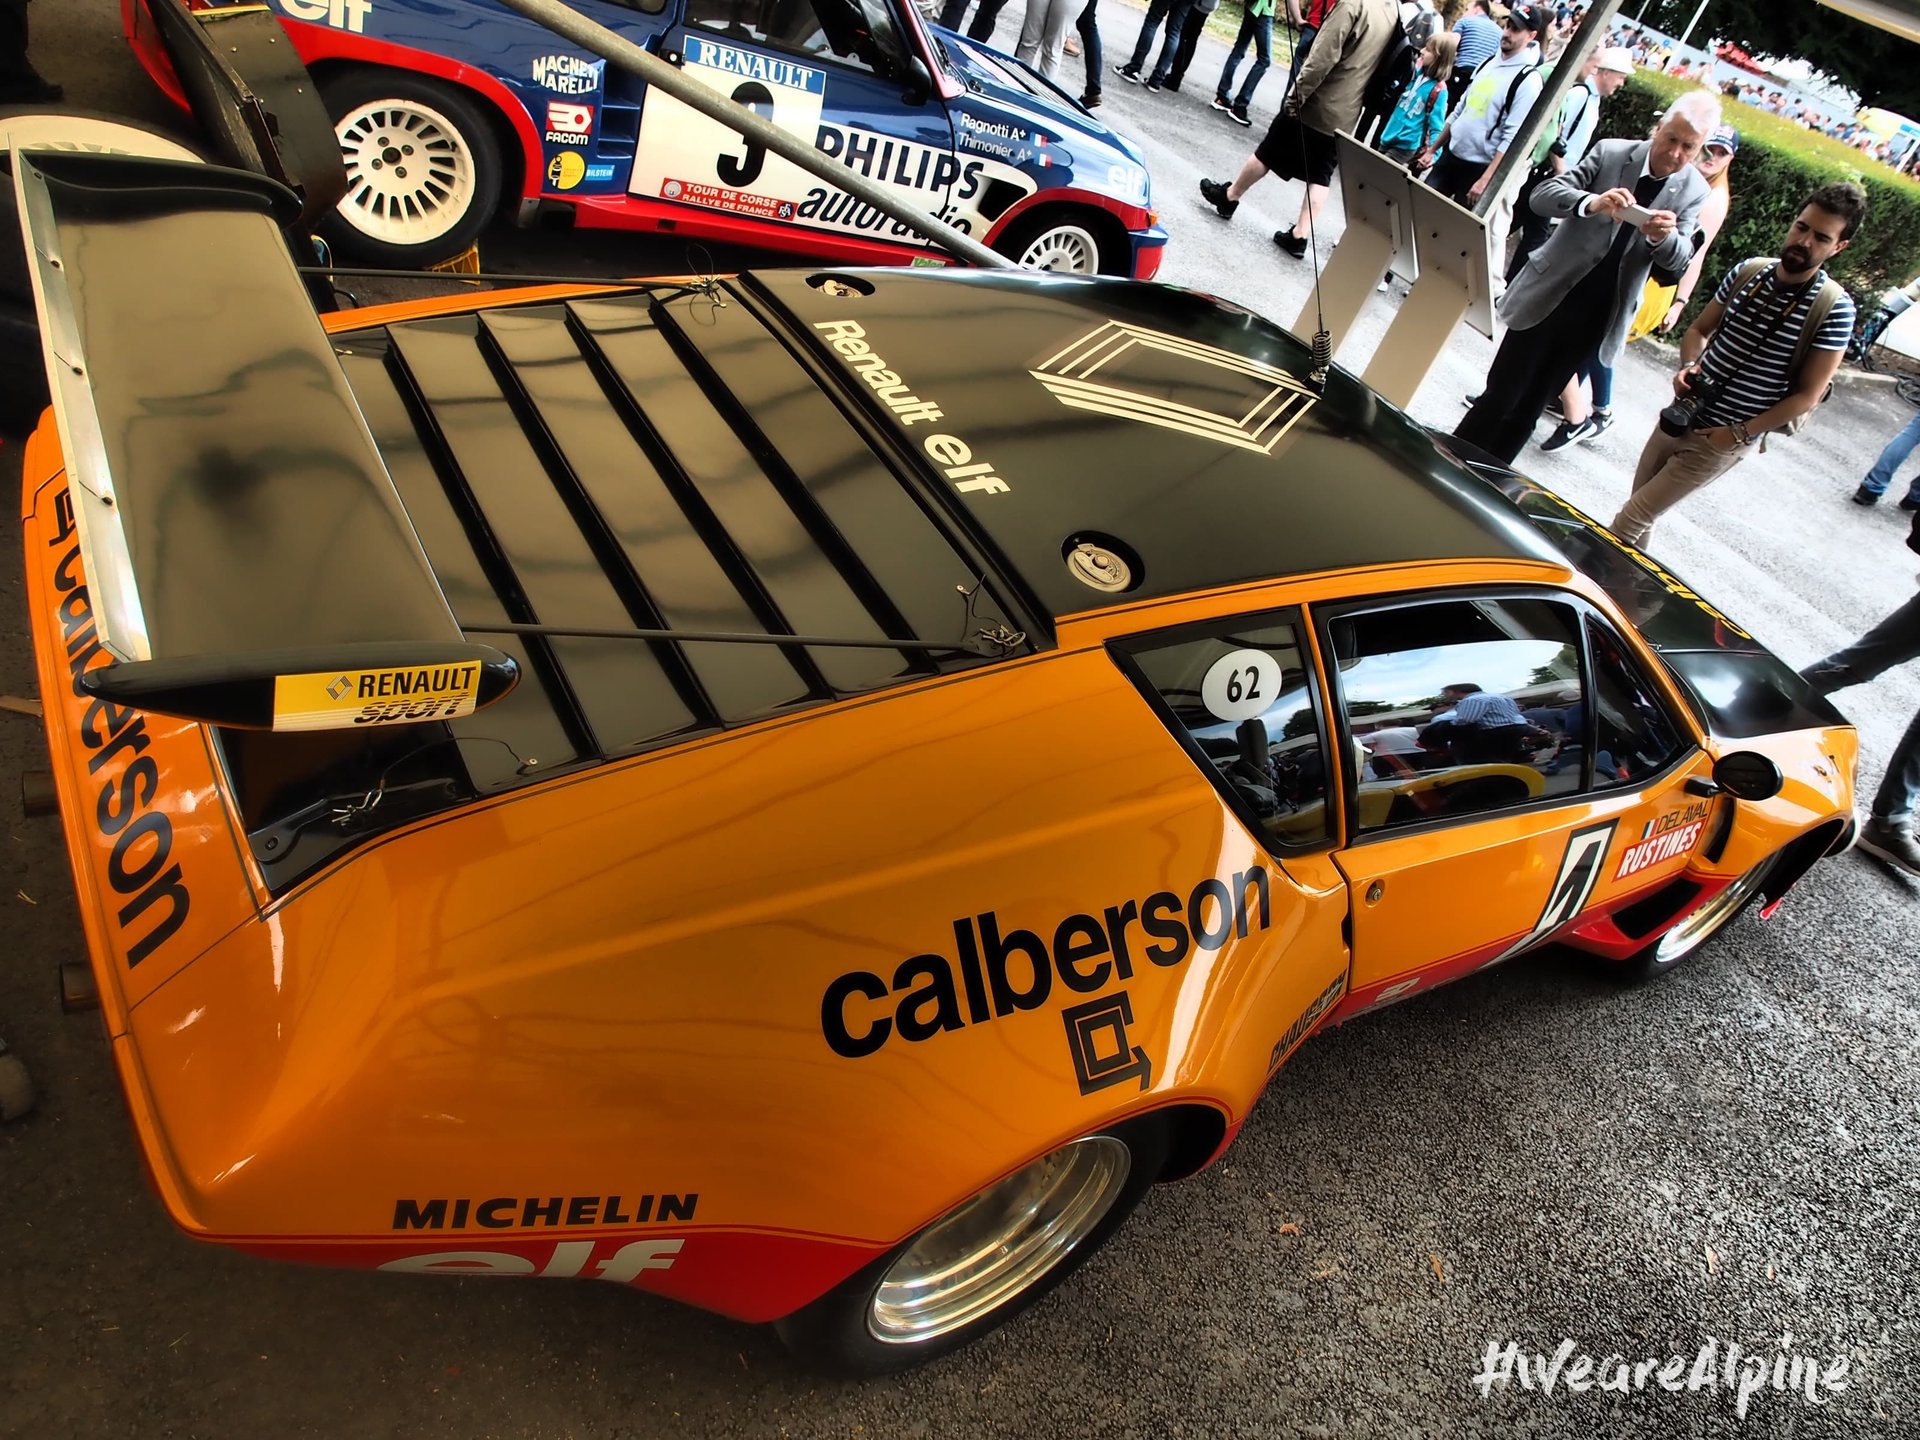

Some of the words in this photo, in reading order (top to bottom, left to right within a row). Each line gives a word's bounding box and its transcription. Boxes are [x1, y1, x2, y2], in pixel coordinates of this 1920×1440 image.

[697, 42, 813, 90] RENAULT
[545, 131, 589, 145] FACOM
[960, 115, 1010, 138] Ragnotti
[959, 132, 1013, 158] Thimonier
[586, 168, 613, 178] BILSTEIN
[815, 125, 984, 199] PHILIPS
[686, 183, 720, 198] TOUR
[721, 189, 737, 201] DE
[739, 193, 779, 209] CORSE
[1107, 165, 1144, 197] elf
[682, 193, 721, 208] RALLYE
[722, 201, 735, 210] DE
[737, 204, 775, 217] FRANCE
[813, 320, 944, 425] Renault
[924, 434, 1011, 494] elf
[358, 666, 477, 698] RENAULT
[1226, 665, 1260, 703] 62
[354, 692, 469, 724] sport
[1656, 801, 1708, 834] DELAVAL
[1616, 821, 1703, 879] RUSTINES
[820, 864, 1272, 1059] calberson
[392, 1193, 699, 1230] MICHELIN
